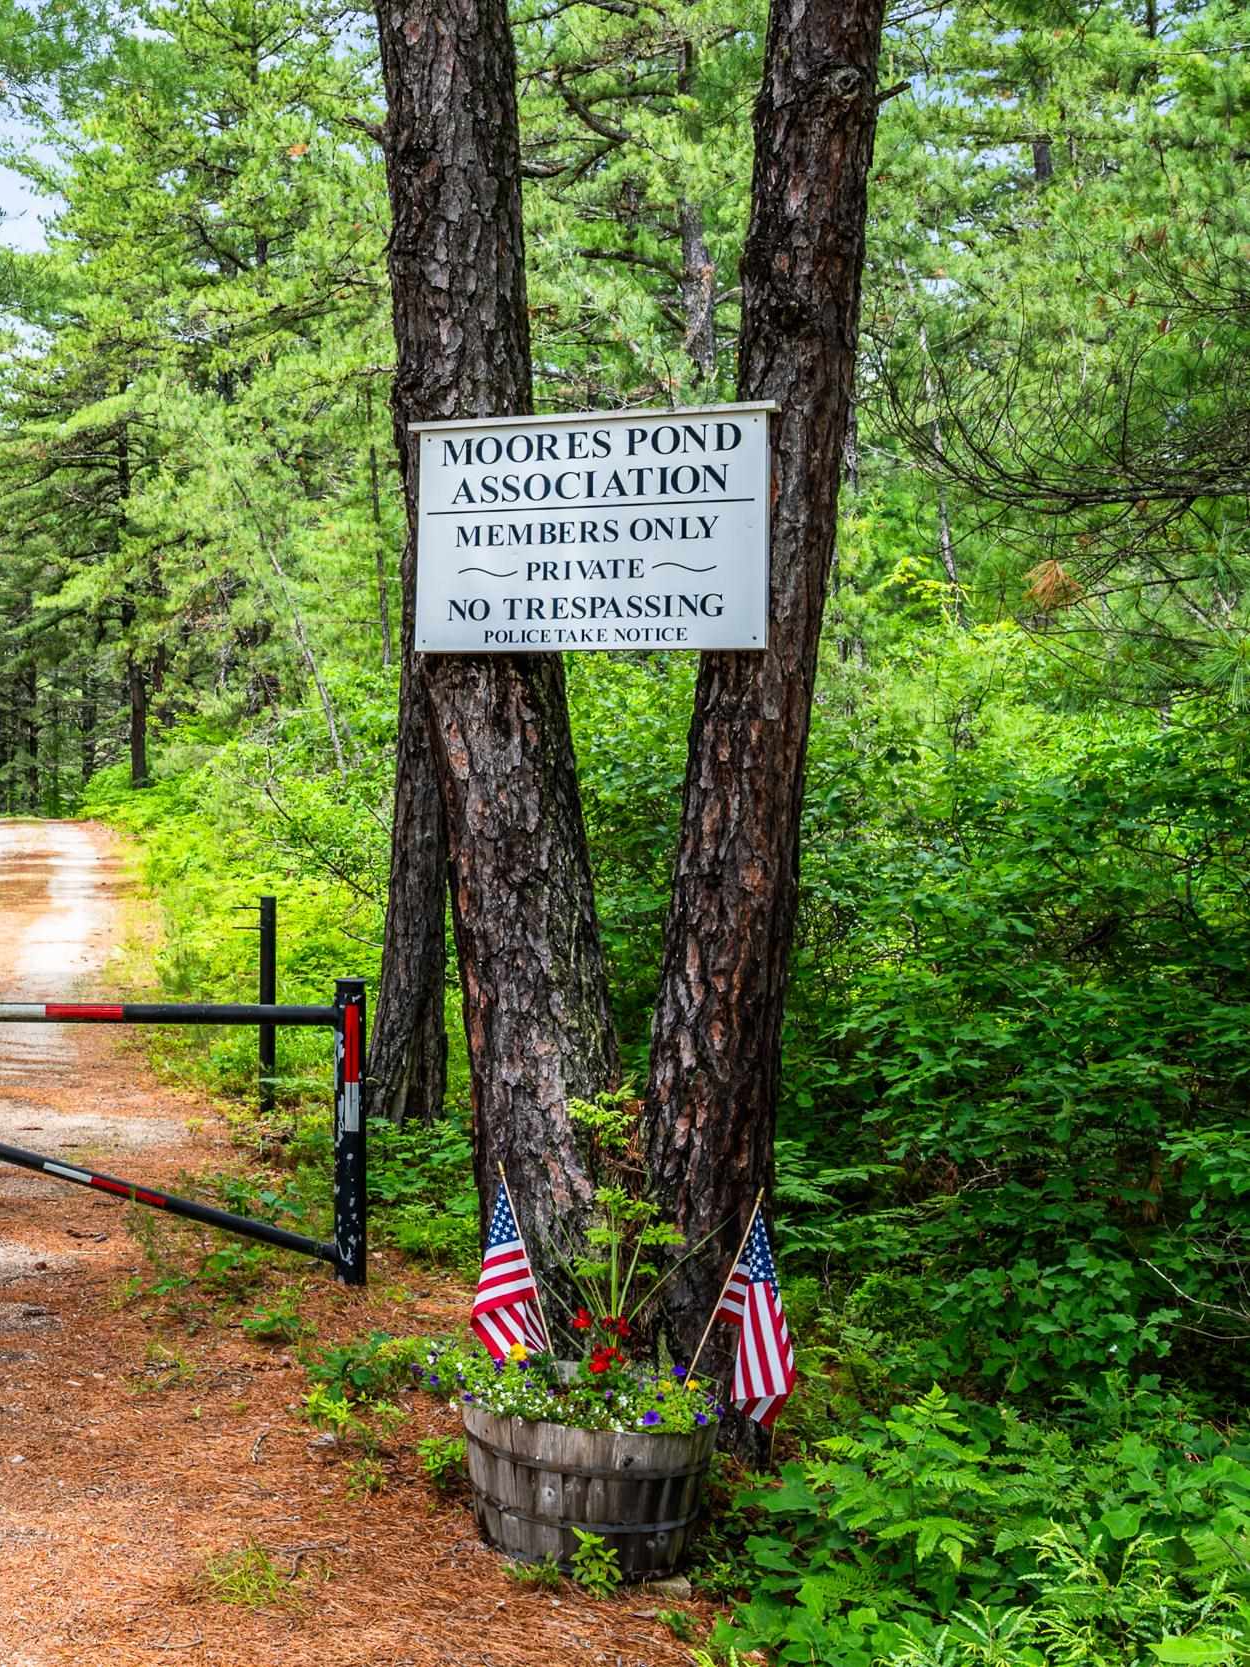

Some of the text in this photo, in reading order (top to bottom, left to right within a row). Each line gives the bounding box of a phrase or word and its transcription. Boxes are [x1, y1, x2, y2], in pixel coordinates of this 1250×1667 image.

[441, 422, 742, 467] MOORES POND
[451, 463, 729, 505] ASSOCIATION
[456, 515, 719, 547] MEMBERS ONLY
[526, 558, 645, 581] PRIVATE
[447, 593, 725, 622] NO TRESPASSING
[484, 627, 688, 644] POLICE TAKE NOTICE
